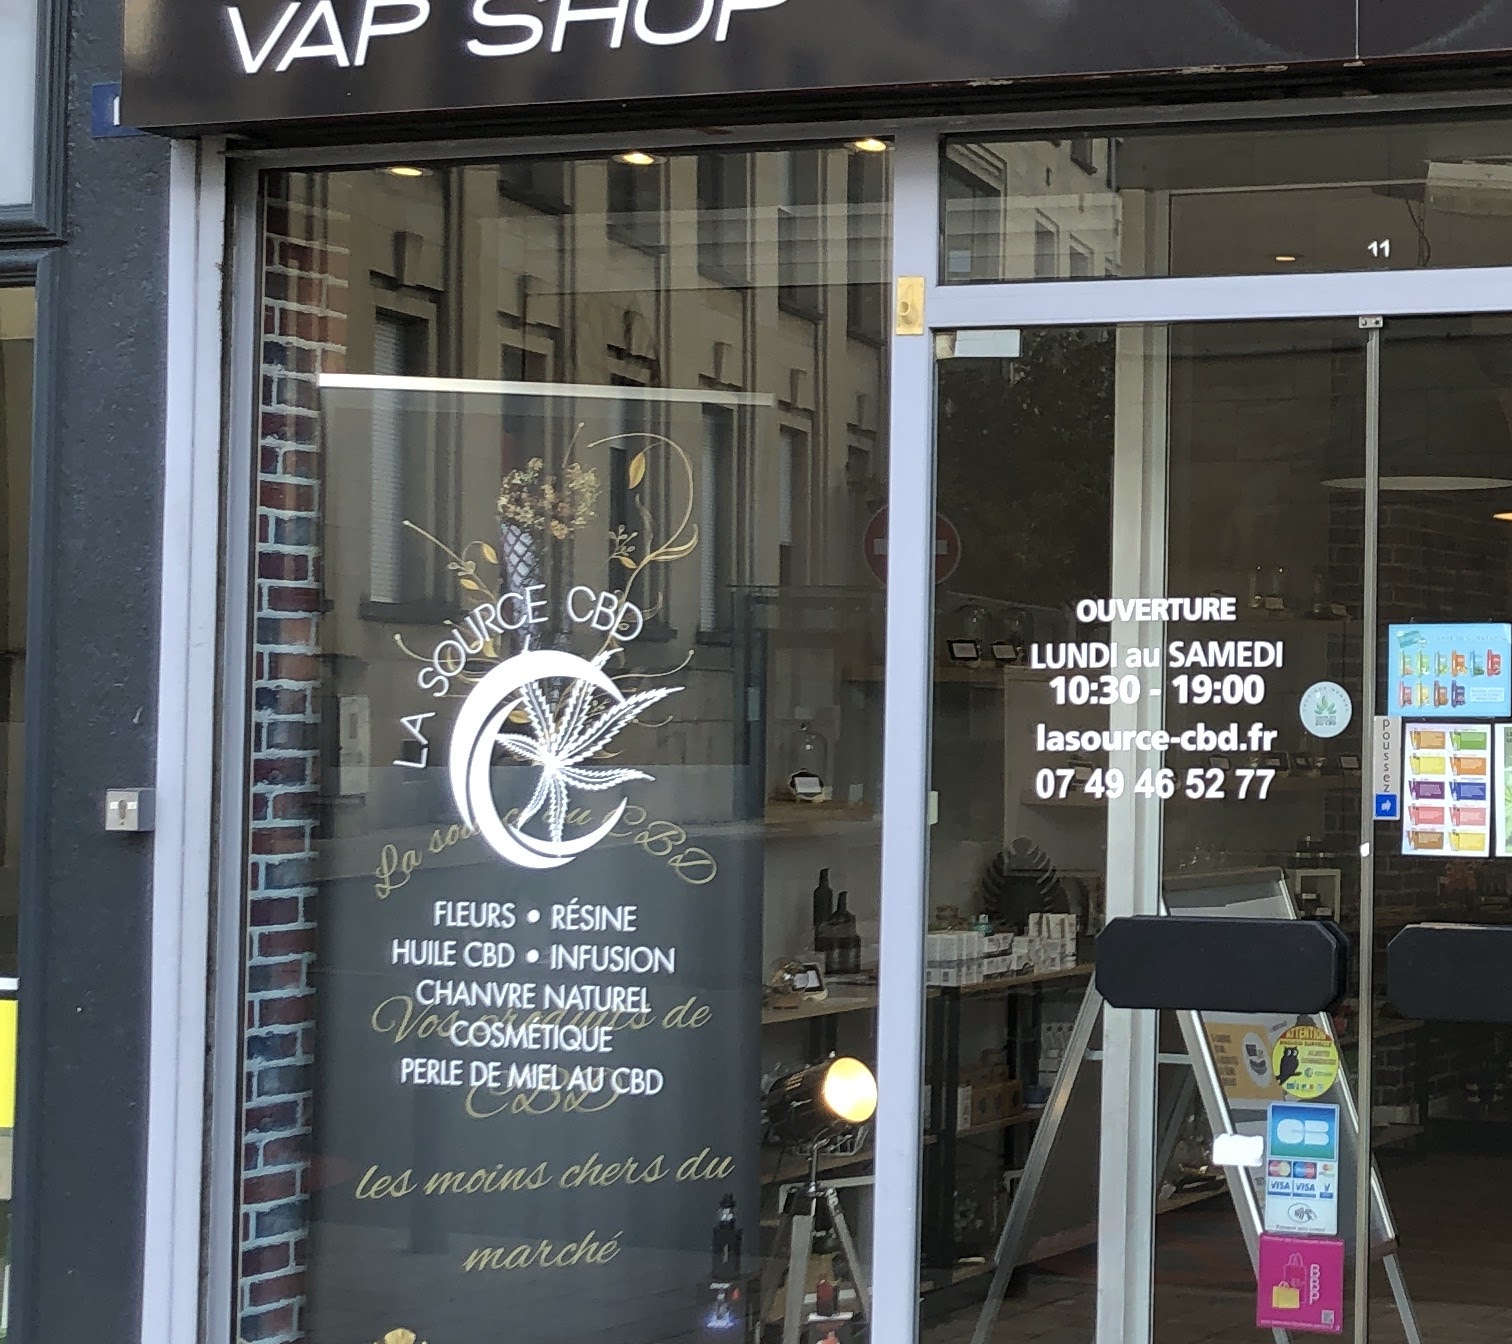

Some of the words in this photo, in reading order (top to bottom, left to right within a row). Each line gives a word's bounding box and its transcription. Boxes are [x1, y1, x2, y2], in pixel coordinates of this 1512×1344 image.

[1367, 239, 1390, 258] 11
[1076, 597, 1237, 623] OUVERTURE
[1030, 642, 1118, 670] LUNDI
[1125, 646, 1160, 668] au
[1168, 641, 1284, 668] SAMEDI
[393, 712, 436, 769] LA
[417, 584, 549, 698] SOURCE
[567, 585, 644, 642] CBD
[1049, 674, 1141, 705] 10:30
[1171, 674, 1266, 705] 19:00
[1036, 722, 1278, 752] lasource-cbd.fr
[1382, 719, 1391, 793] poussez
[1036, 768, 1074, 800] 07
[1084, 768, 1125, 800] 49
[1134, 768, 1175, 800] 46
[1185, 768, 1226, 800] 52
[1235, 768, 1276, 800] 77
[433, 900, 517, 929] FLEURS
[550, 897, 638, 932] RÉSINE
[391, 939, 458, 967] HUILE
[463, 942, 516, 969] CBD
[549, 944, 676, 974] INFUSION
[416, 979, 537, 1010] CHANVRE
[543, 984, 652, 1014] NATUREL
[662, 996, 713, 1030] de
[449, 1018, 614, 1053] COSMÉTIQUE
[400, 1058, 464, 1087] PERLE
[470, 1061, 500, 1089] DE
[507, 1064, 561, 1090] MIEL
[566, 1066, 605, 1094] AU
[610, 1068, 665, 1096] CBD
[355, 1164, 418, 1200] les
[424, 1164, 552, 1196] moins
[558, 1152, 670, 1188] chers
[676, 1147, 735, 1182] du
[1271, 1181, 1290, 1191] VISA
[1296, 1182, 1316, 1192] VISA
[462, 1229, 625, 1272] marché
